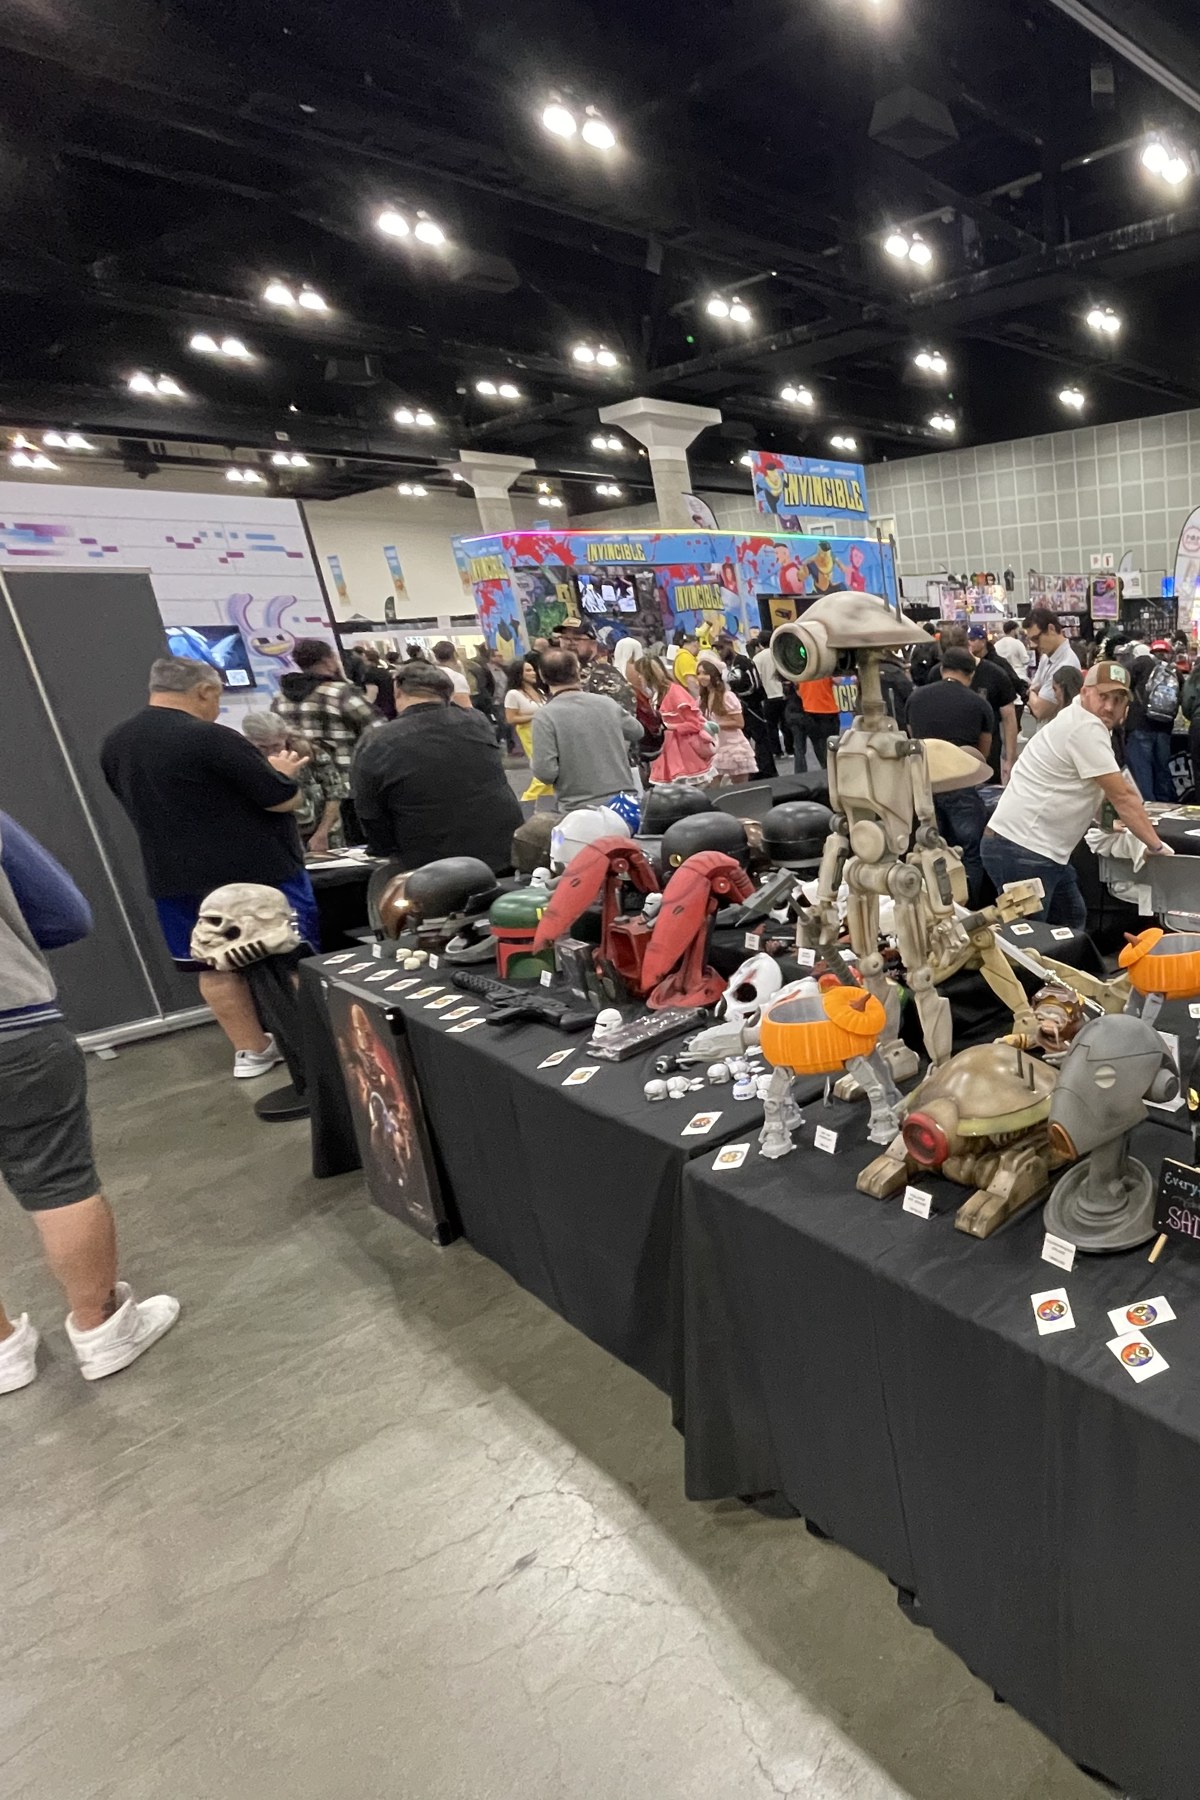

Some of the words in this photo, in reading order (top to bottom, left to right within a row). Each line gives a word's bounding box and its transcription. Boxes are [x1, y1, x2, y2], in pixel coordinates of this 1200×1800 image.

[784, 472, 865, 512] INVINCIBLE
[587, 543, 646, 562] INVINCIBLE
[674, 584, 725, 612] INVINCIBLE
